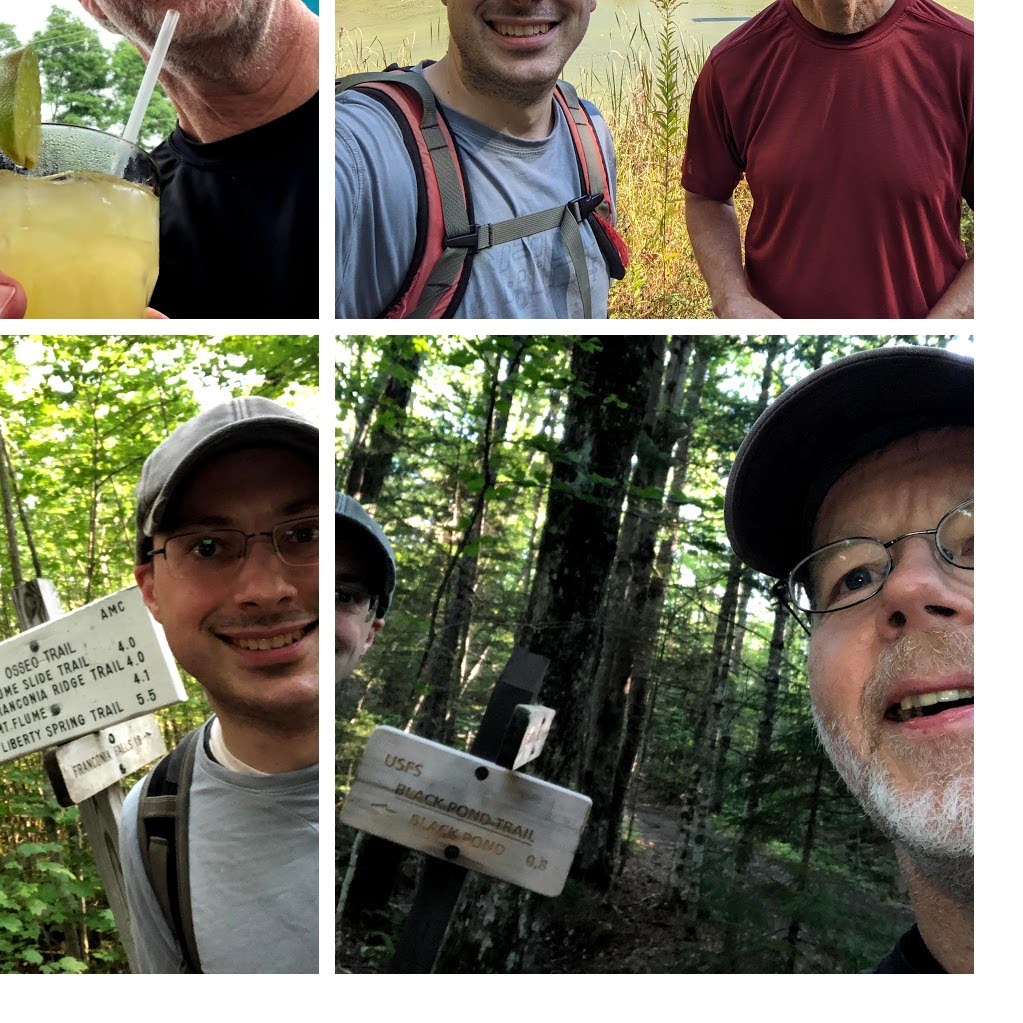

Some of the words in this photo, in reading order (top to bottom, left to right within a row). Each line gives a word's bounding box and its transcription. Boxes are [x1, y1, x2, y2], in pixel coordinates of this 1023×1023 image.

[100, 600, 126, 621] AMC
[4, 656, 40, 680] OSSEO
[42, 641, 77, 663] TRAIL
[23, 669, 52, 691] SLIDE
[57, 655, 90, 677] TRAIL
[117, 636, 137, 653] 4.0
[53, 673, 86, 696] RIDGE
[89, 659, 125, 681] TRAIL
[126, 650, 146, 668] 4.0
[133, 669, 151, 685] 4.1
[1, 728, 43, 753] LIBERTY
[46, 714, 86, 737] SPRING
[89, 700, 125, 722] TRAIL
[136, 688, 157, 706] 5.5
[72, 750, 112, 778] FRANCONIA
[113, 739, 134, 757] FALLS
[384, 753, 424, 777] USFS
[395, 783, 444, 809] BLACK
[447, 801, 490, 826] POND
[496, 817, 535, 843] TRAIL
[410, 813, 459, 840] BLACK
[462, 831, 506, 856] POND
